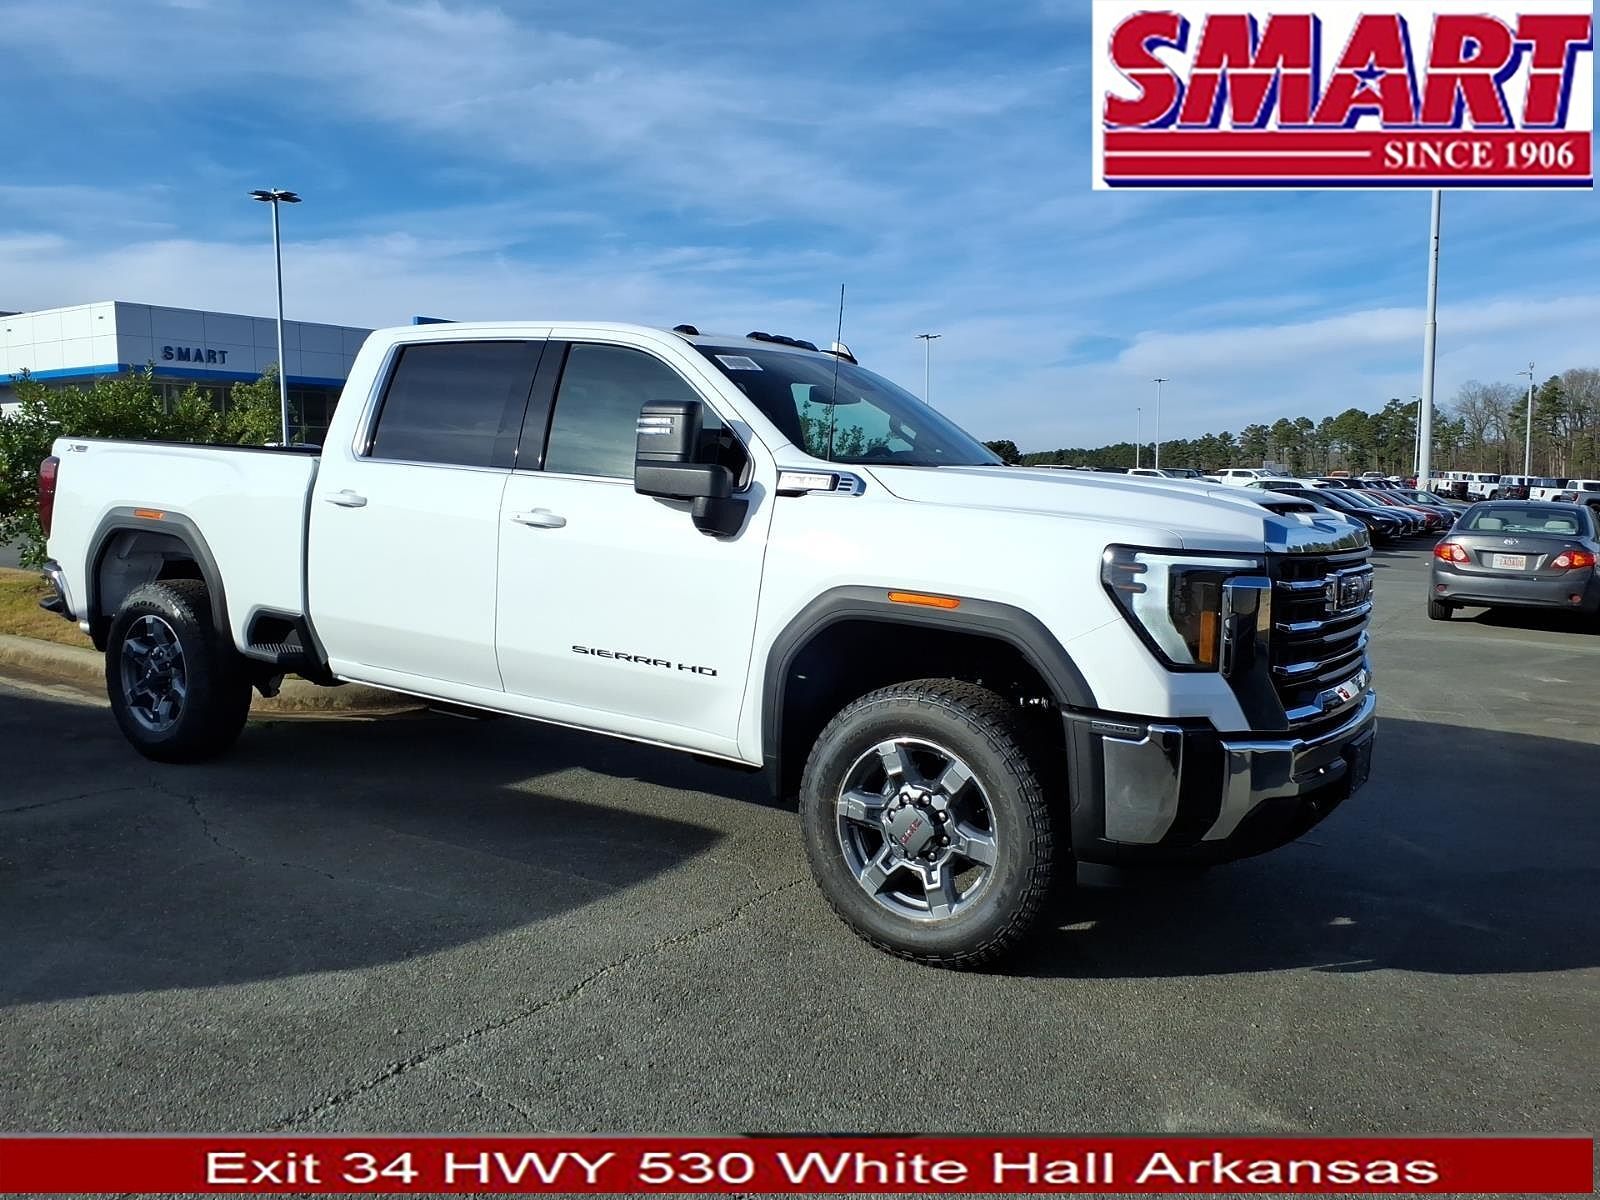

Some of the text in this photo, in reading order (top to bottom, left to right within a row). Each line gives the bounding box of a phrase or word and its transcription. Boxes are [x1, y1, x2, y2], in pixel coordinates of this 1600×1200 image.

[162, 345, 228, 364] SMART
[571, 645, 718, 677] SIERRA HD
